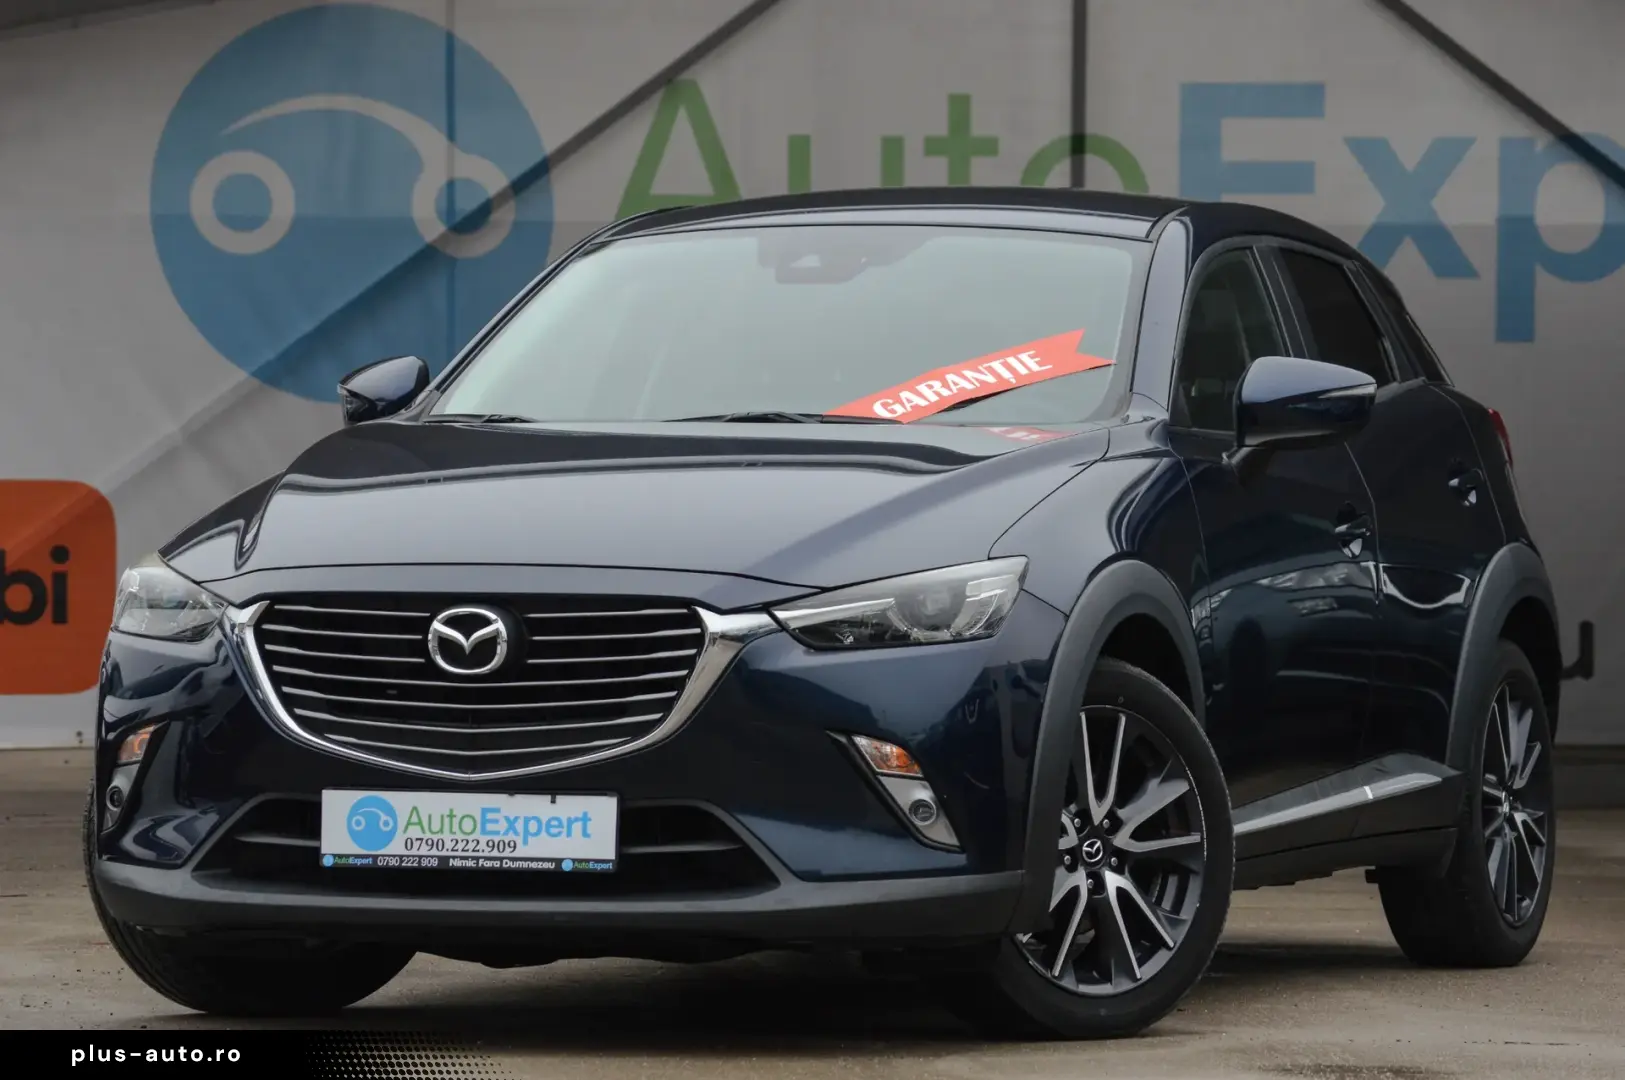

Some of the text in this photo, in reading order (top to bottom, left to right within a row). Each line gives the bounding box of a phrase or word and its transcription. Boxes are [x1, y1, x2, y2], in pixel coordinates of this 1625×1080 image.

[872, 350, 1053, 419] GARANȚIE
[403, 806, 592, 846] AutoExpert
[404, 837, 518, 853] 0790.222.909
[334, 856, 613, 871] AutoExpert 0790 222 909 Nimic Fara Dumnezeu AutoExpert
